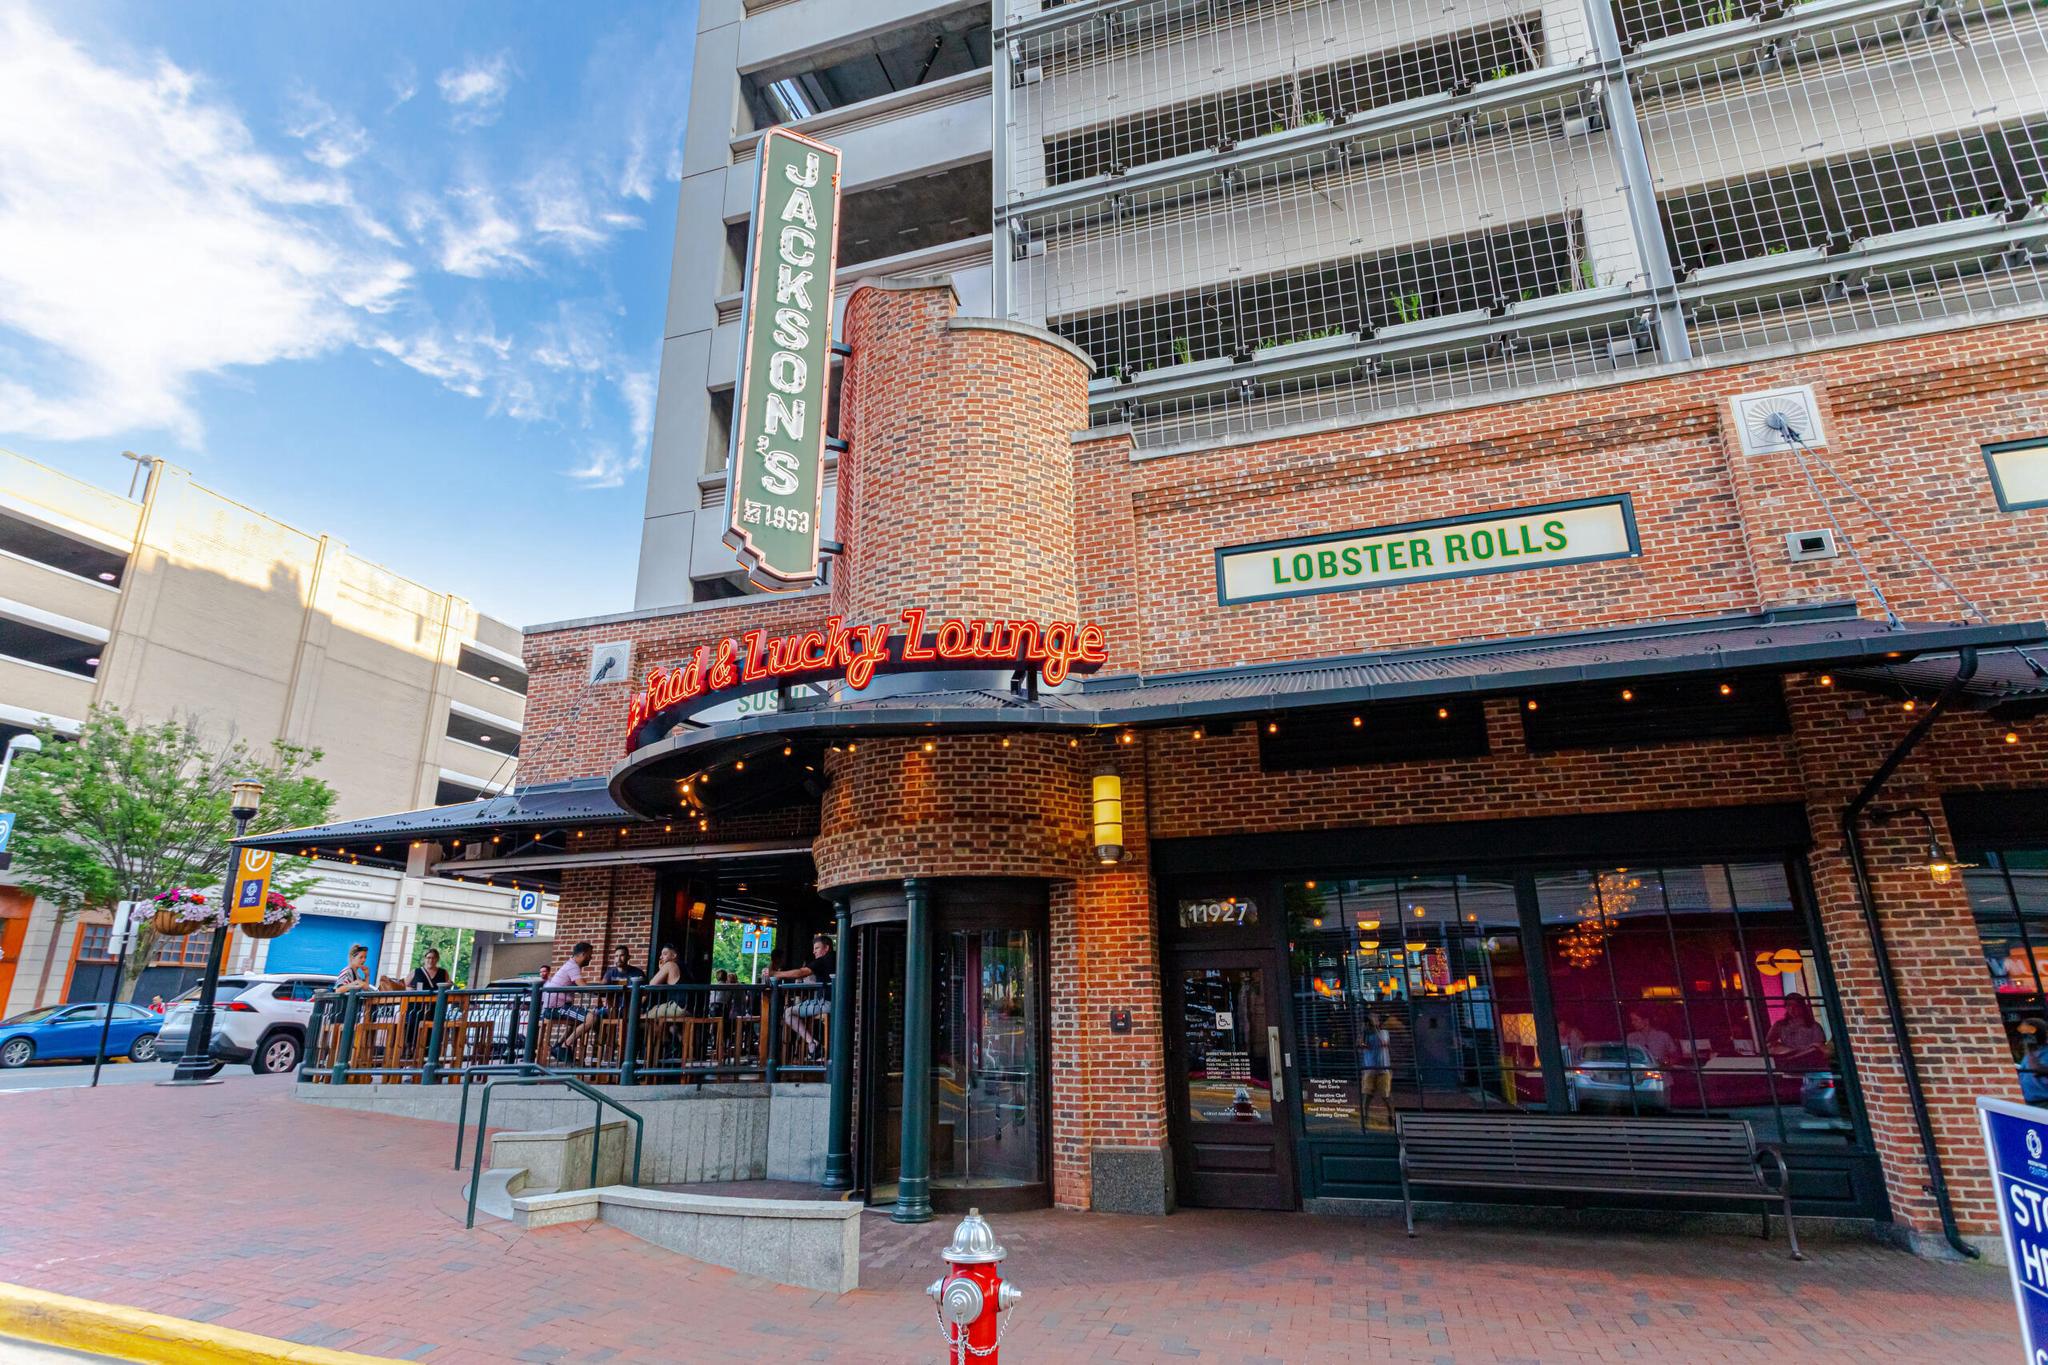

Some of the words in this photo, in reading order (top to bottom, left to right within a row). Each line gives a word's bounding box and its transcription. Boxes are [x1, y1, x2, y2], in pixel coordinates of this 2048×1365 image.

[756, 152, 820, 496] JACKSON'S
[764, 504, 810, 534] 1953
[1273, 538, 1434, 585] LOBSTER
[1444, 520, 1568, 564] ROLLS
[645, 646, 708, 720] Food
[709, 637, 736, 691] &
[741, 615, 891, 692] Lucky
[901, 607, 1110, 687] Lounge
[1188, 902, 1249, 923] 11927
